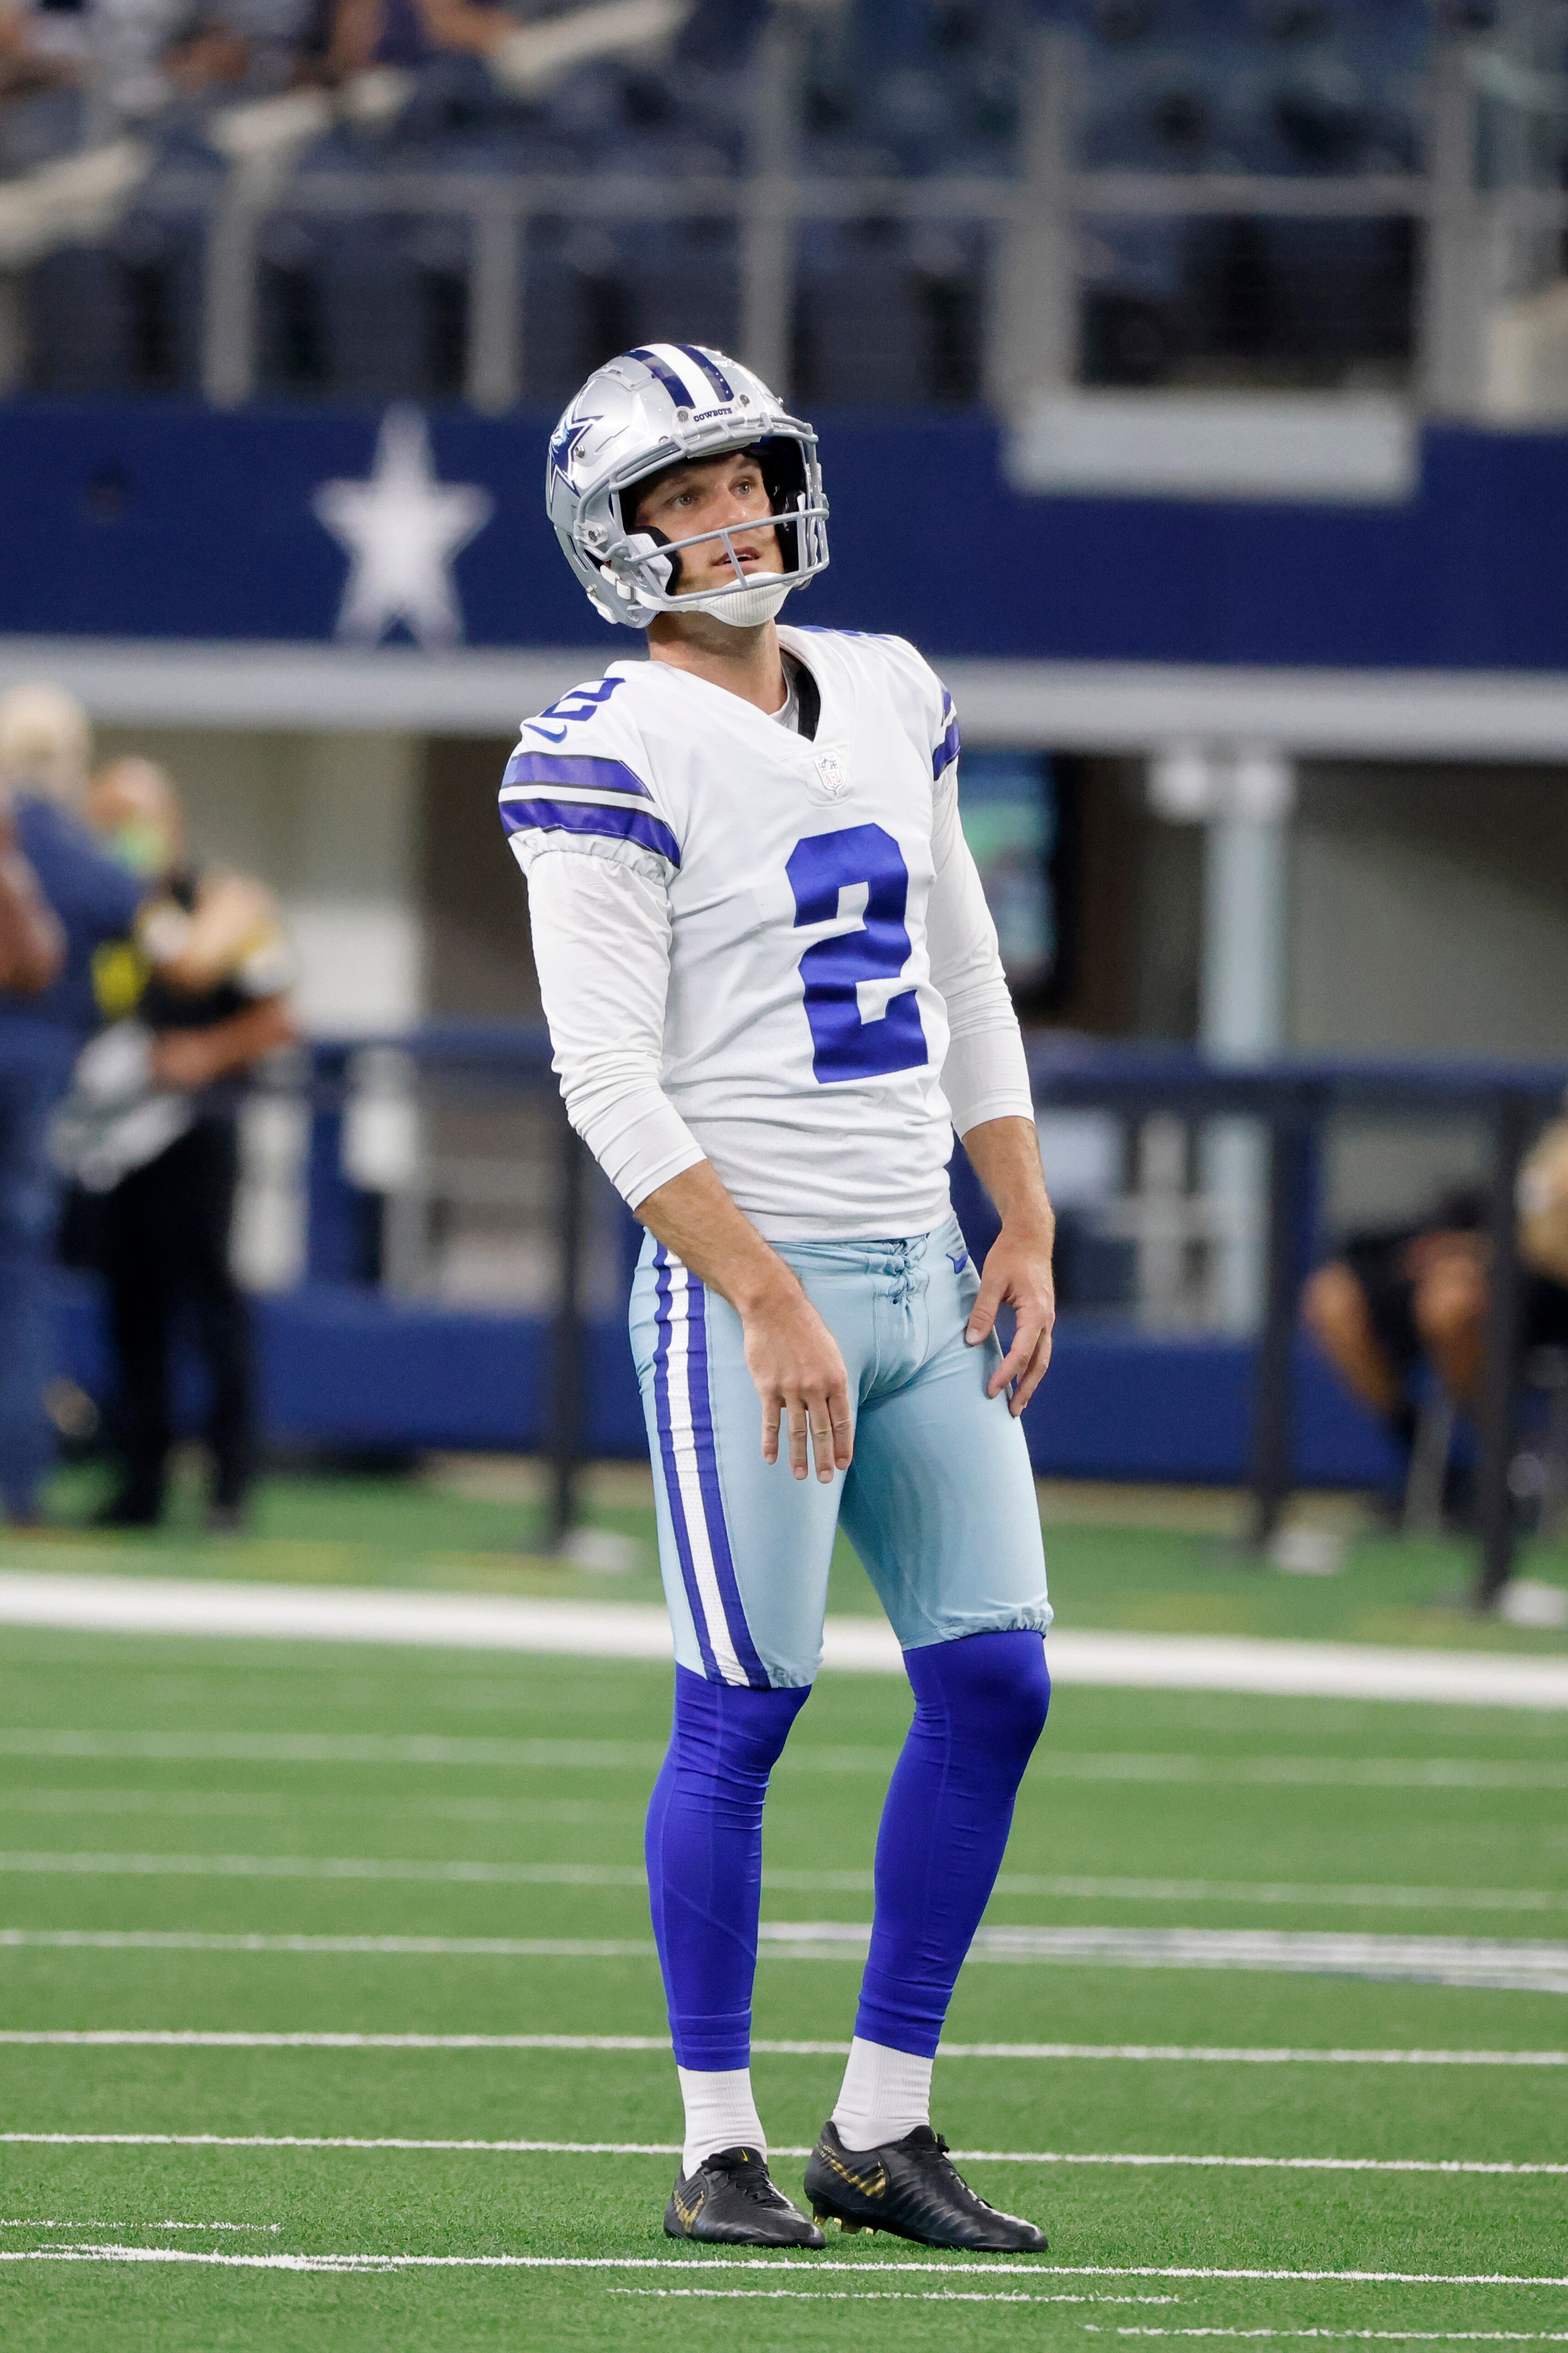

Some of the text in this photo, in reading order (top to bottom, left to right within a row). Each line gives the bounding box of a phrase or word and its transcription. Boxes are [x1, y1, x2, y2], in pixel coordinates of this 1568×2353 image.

[693, 408, 732, 422] COWBOYS
[824, 771, 841, 785] NFL
[785, 823, 928, 1084] 2
